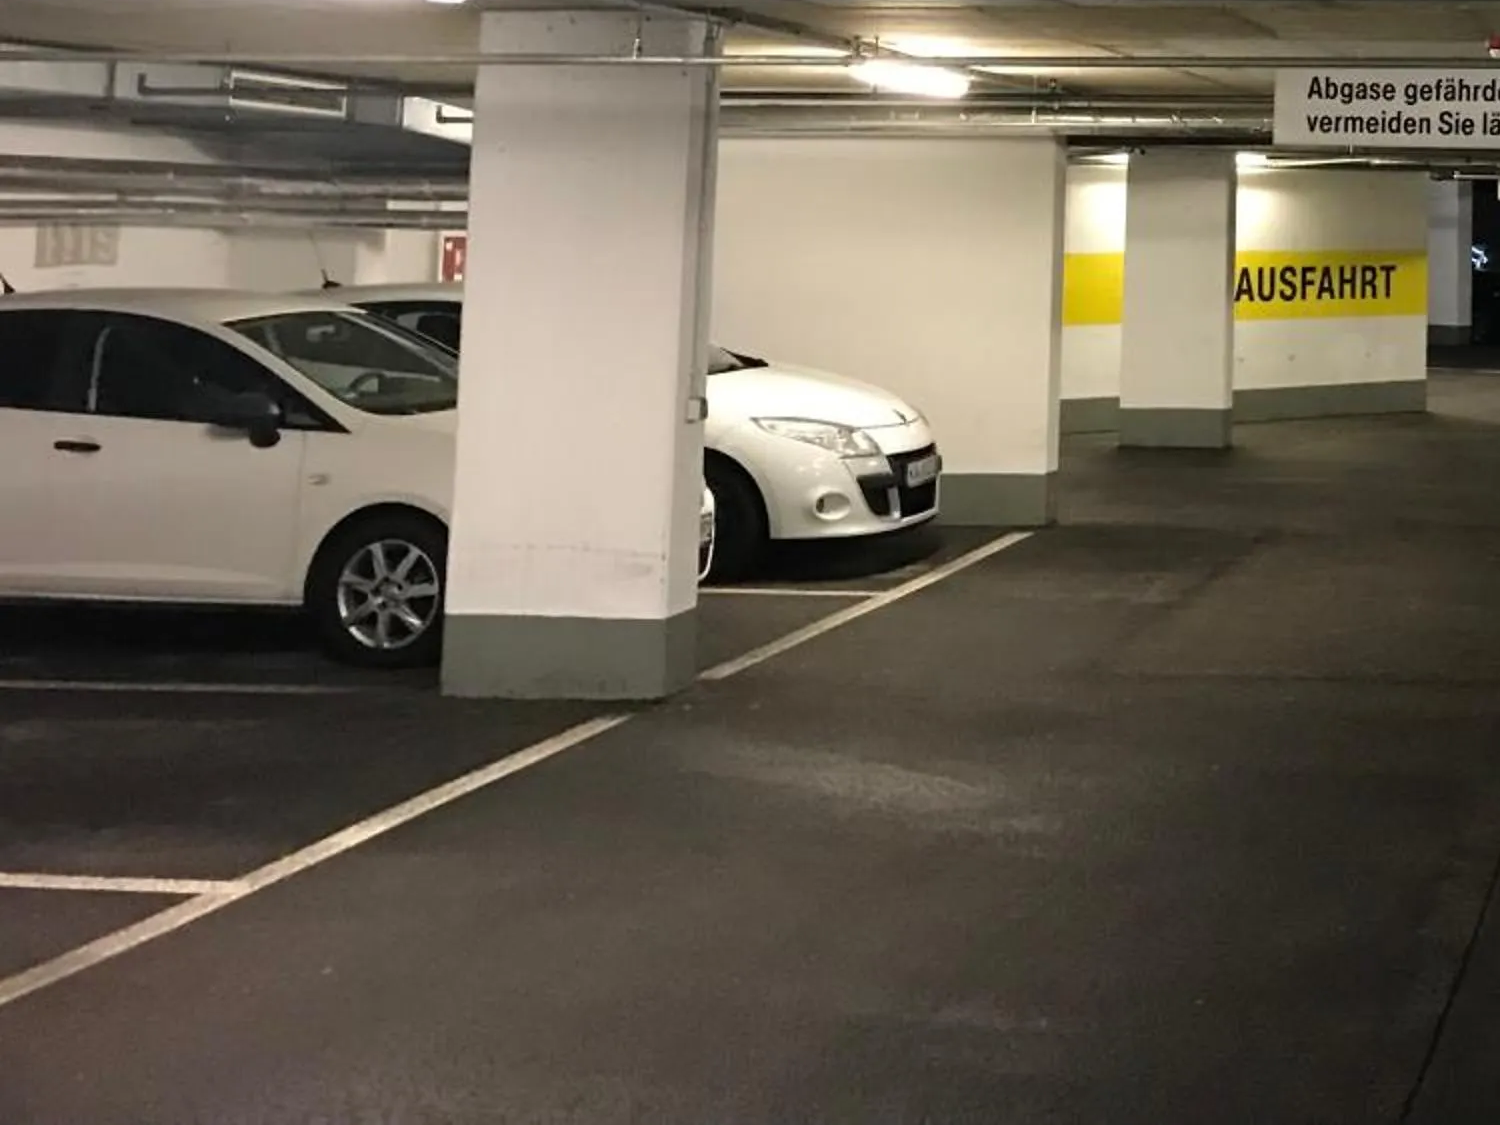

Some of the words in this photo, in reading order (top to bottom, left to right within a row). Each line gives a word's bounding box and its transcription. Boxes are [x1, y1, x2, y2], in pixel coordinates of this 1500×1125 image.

[1307, 76, 1396, 104] Abgase
[1307, 111, 1431, 134] vermeiden
[1438, 110, 1475, 136] Sie
[1234, 265, 1397, 302] AUSFAHRT
